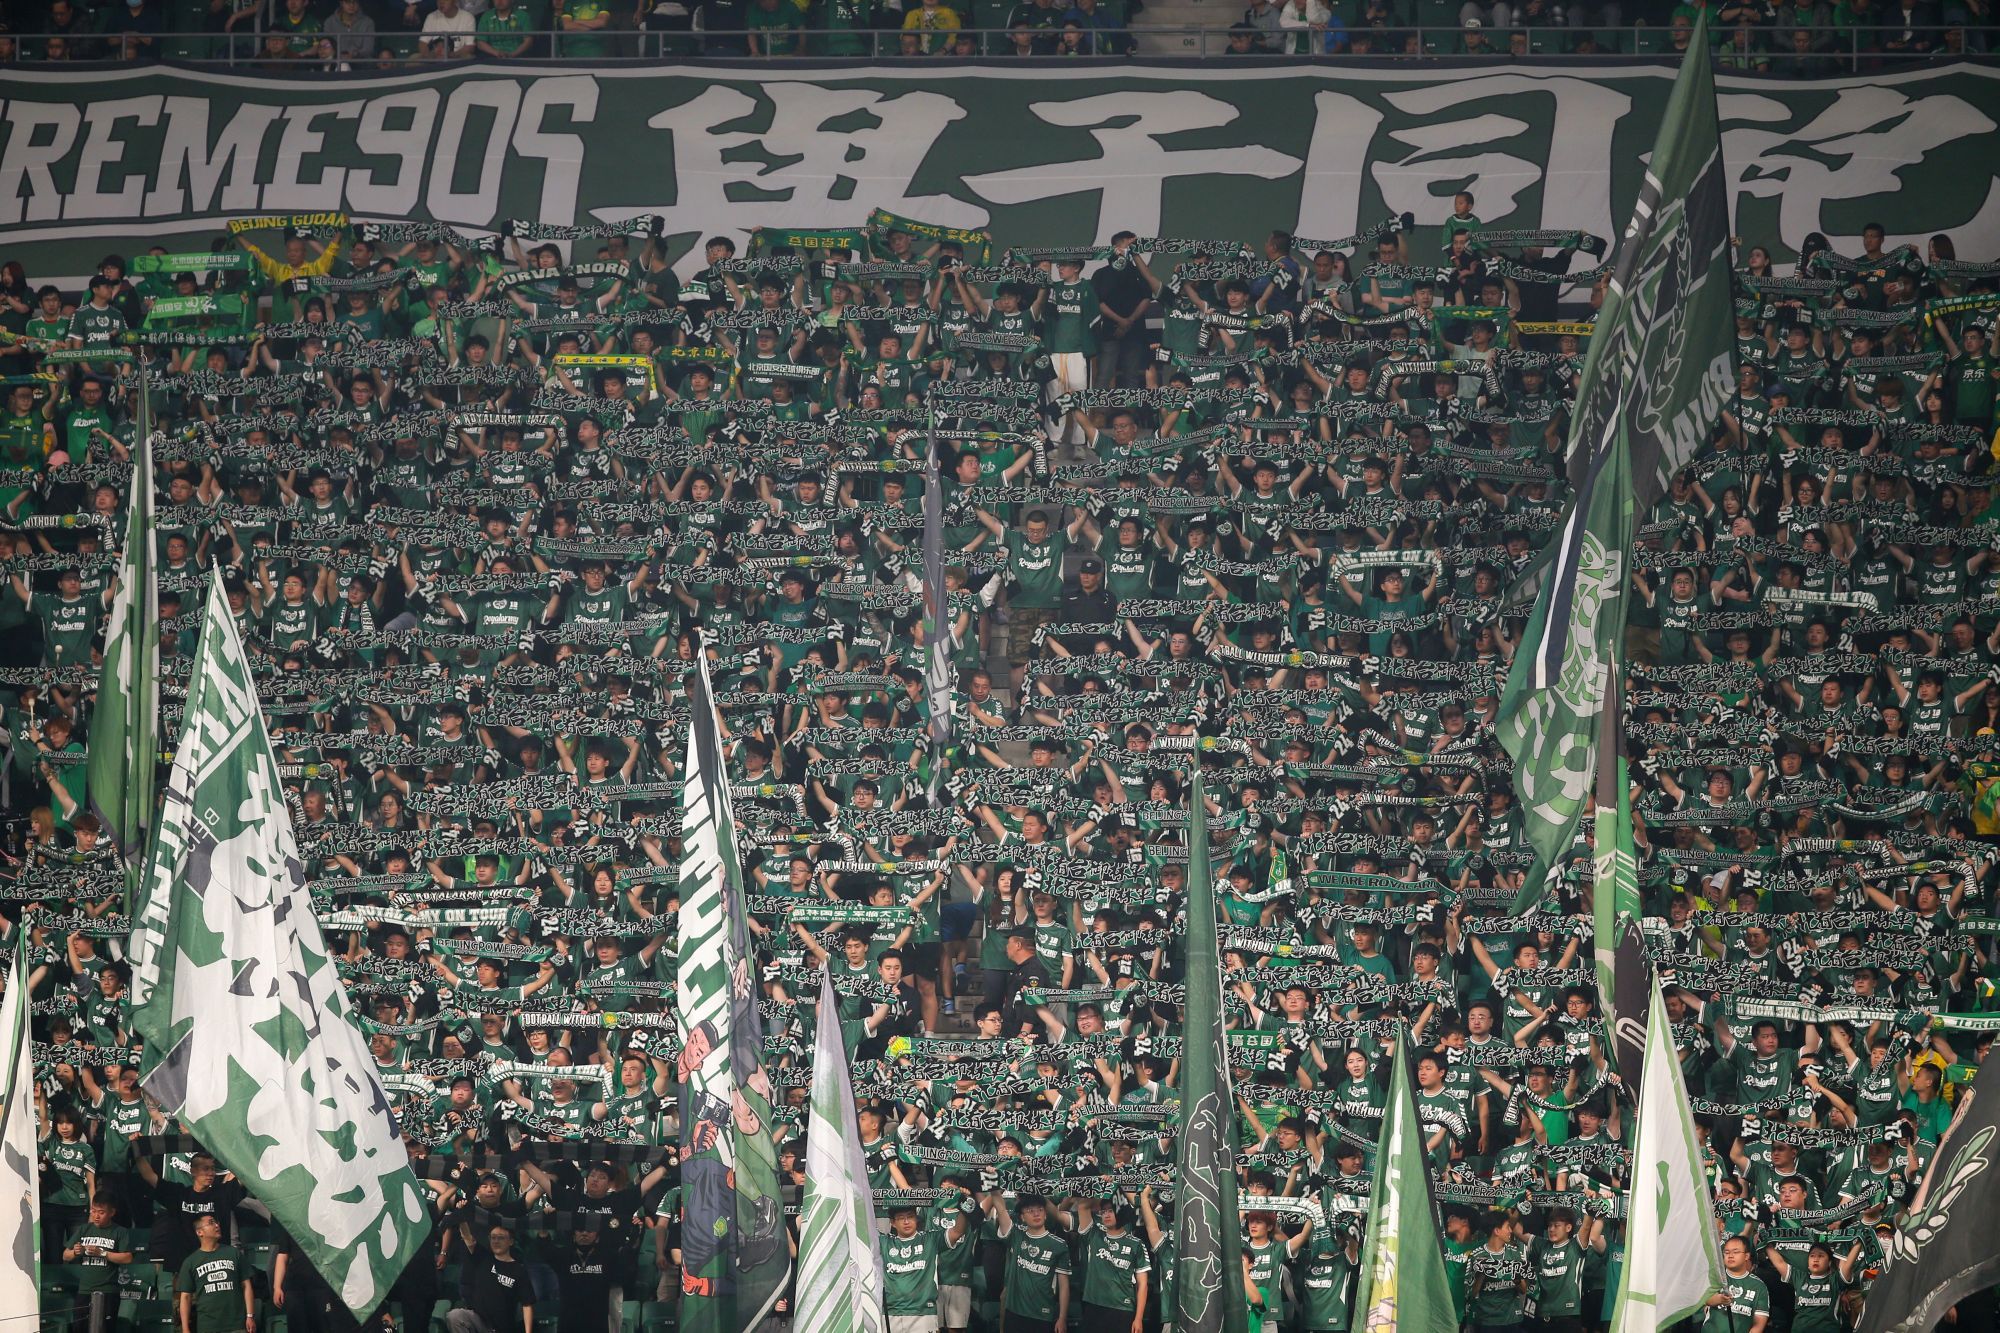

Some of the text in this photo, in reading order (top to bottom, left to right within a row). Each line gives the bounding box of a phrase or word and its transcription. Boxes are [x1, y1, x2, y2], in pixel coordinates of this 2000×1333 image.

[227, 216, 288, 233] BEIJING
[577, 263, 630, 280] NORD
[1397, 361, 1436, 373] WITHOUT
[1470, 362, 1480, 371] IS
[23, 515, 59, 527] WITHOUT
[1246, 651, 1285, 664] WITHOUT
[906, 779, 924, 798] 24
[1148, 846, 1188, 857] BEIJING
[1796, 840, 1836, 851] WITHOUT
[1318, 874, 1337, 885] WE
[1340, 876, 1366, 888] ARE
[1368, 877, 1410, 891] ROYAL
[541, 916, 559, 935] 24
[1234, 938, 1273, 951] WITHOUT
[521, 1013, 561, 1025] FOOTBALL
[564, 1013, 600, 1026] WITHOUT
[957, 1019, 971, 1028] 16
[1268, 1051, 1285, 1070] 24
[886, 1261, 925, 1274] Royalarmy
